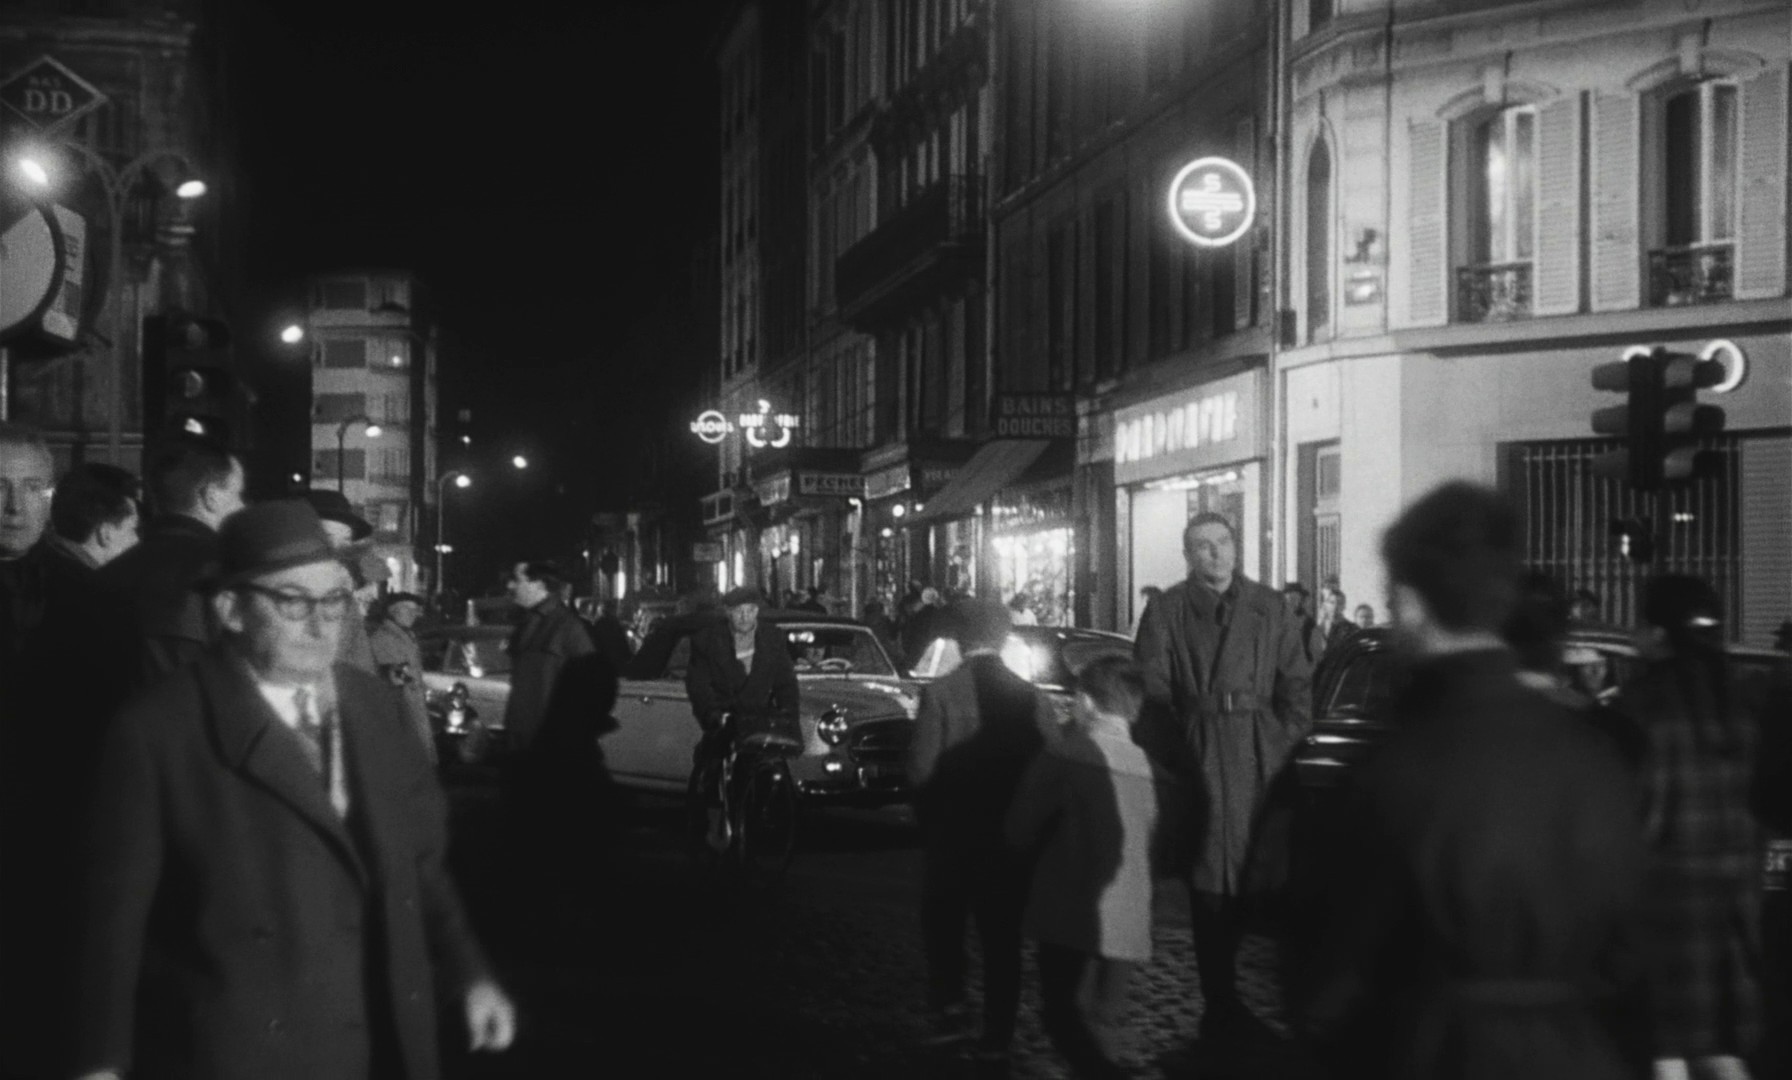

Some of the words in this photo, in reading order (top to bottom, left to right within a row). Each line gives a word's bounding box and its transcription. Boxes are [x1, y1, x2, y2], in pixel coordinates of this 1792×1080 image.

[24, 89, 72, 113] DD
[1003, 396, 1068, 415] BAINS
[998, 417, 1071, 436] DOUCHES
